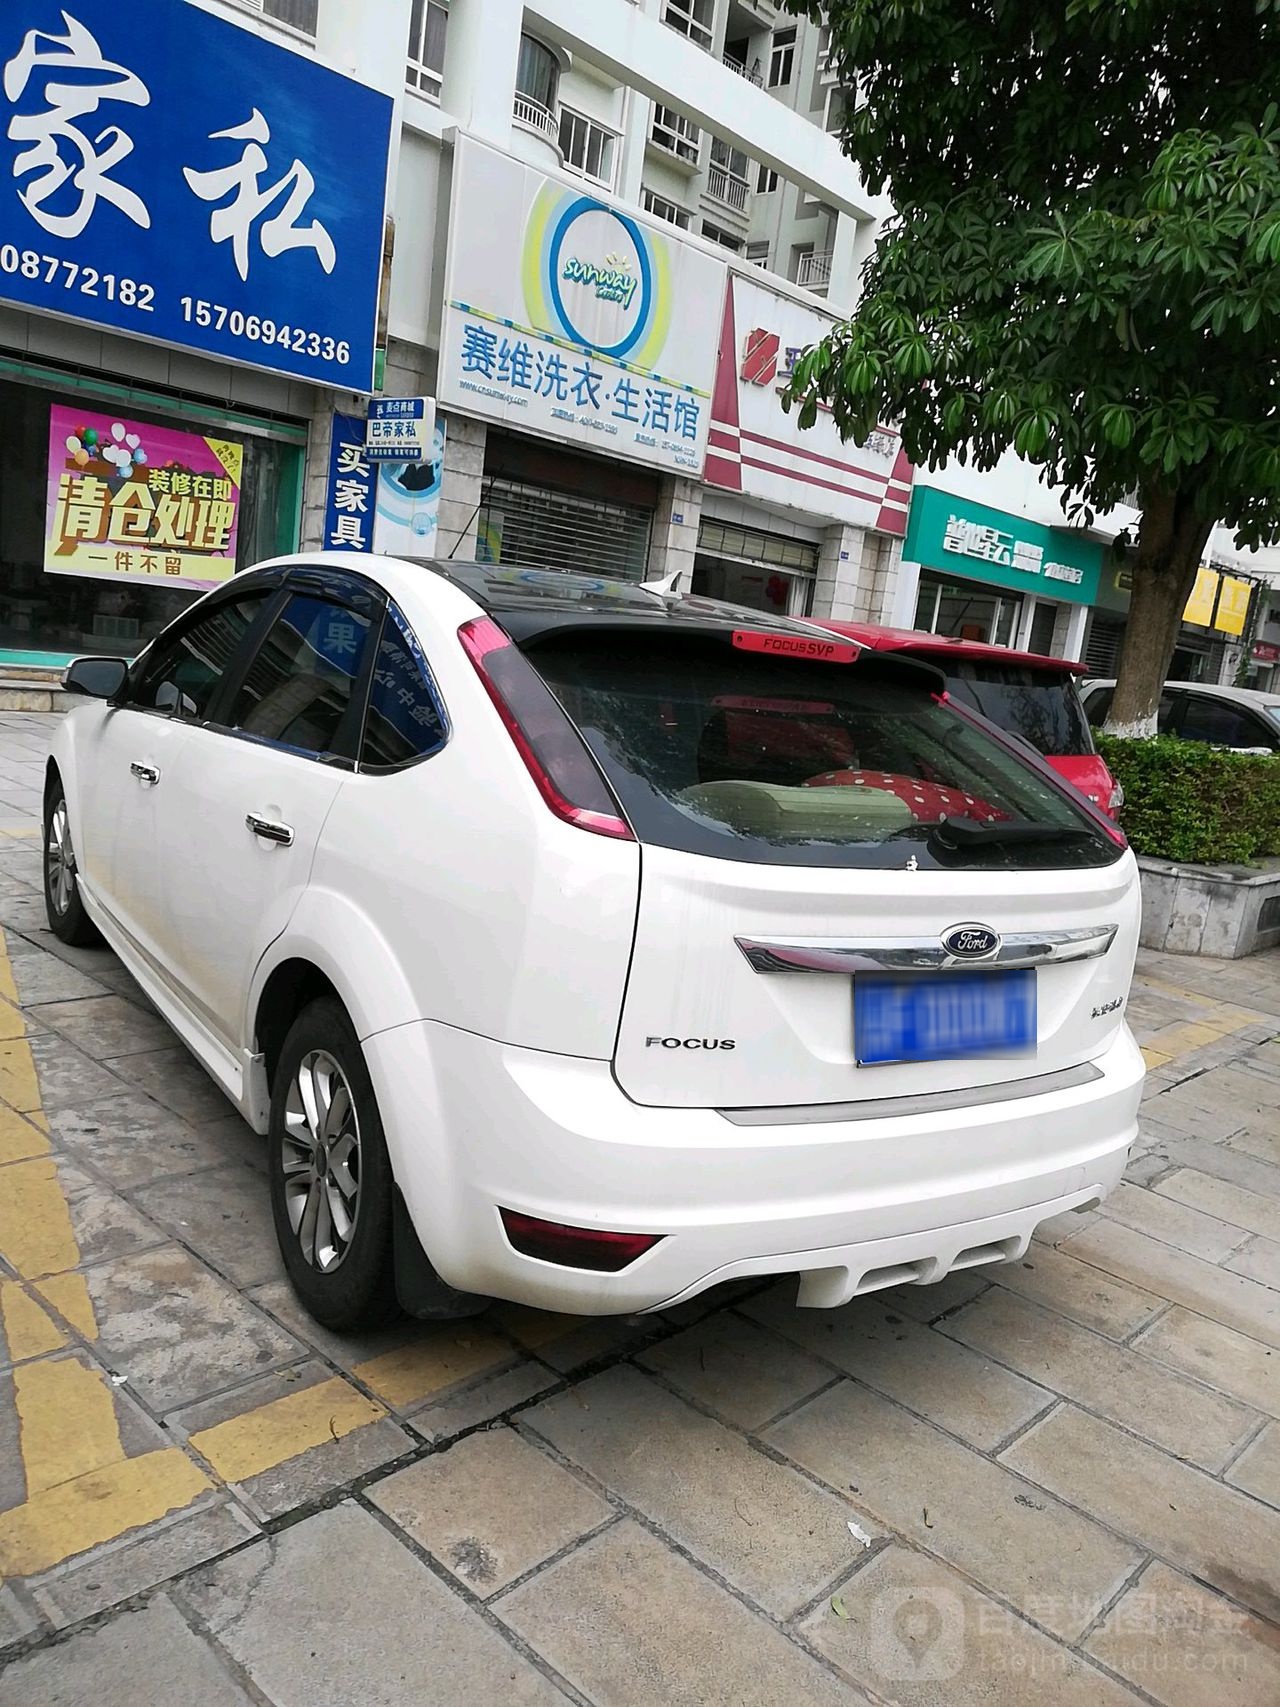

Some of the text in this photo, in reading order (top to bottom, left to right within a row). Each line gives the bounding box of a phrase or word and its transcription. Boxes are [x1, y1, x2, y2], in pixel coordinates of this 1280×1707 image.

[4, 9, 337, 281] 家私
[0, 244, 350, 365] 08772182 15706942336
[50, 473, 237, 550] 清仓处理
[149, 468, 232, 501] 装修在即
[330, 441, 371, 550] 买家具
[88, 550, 182, 576] 一件不留
[957, 931, 988, 950] Ford
[645, 1036, 736, 1050] FOCUS
